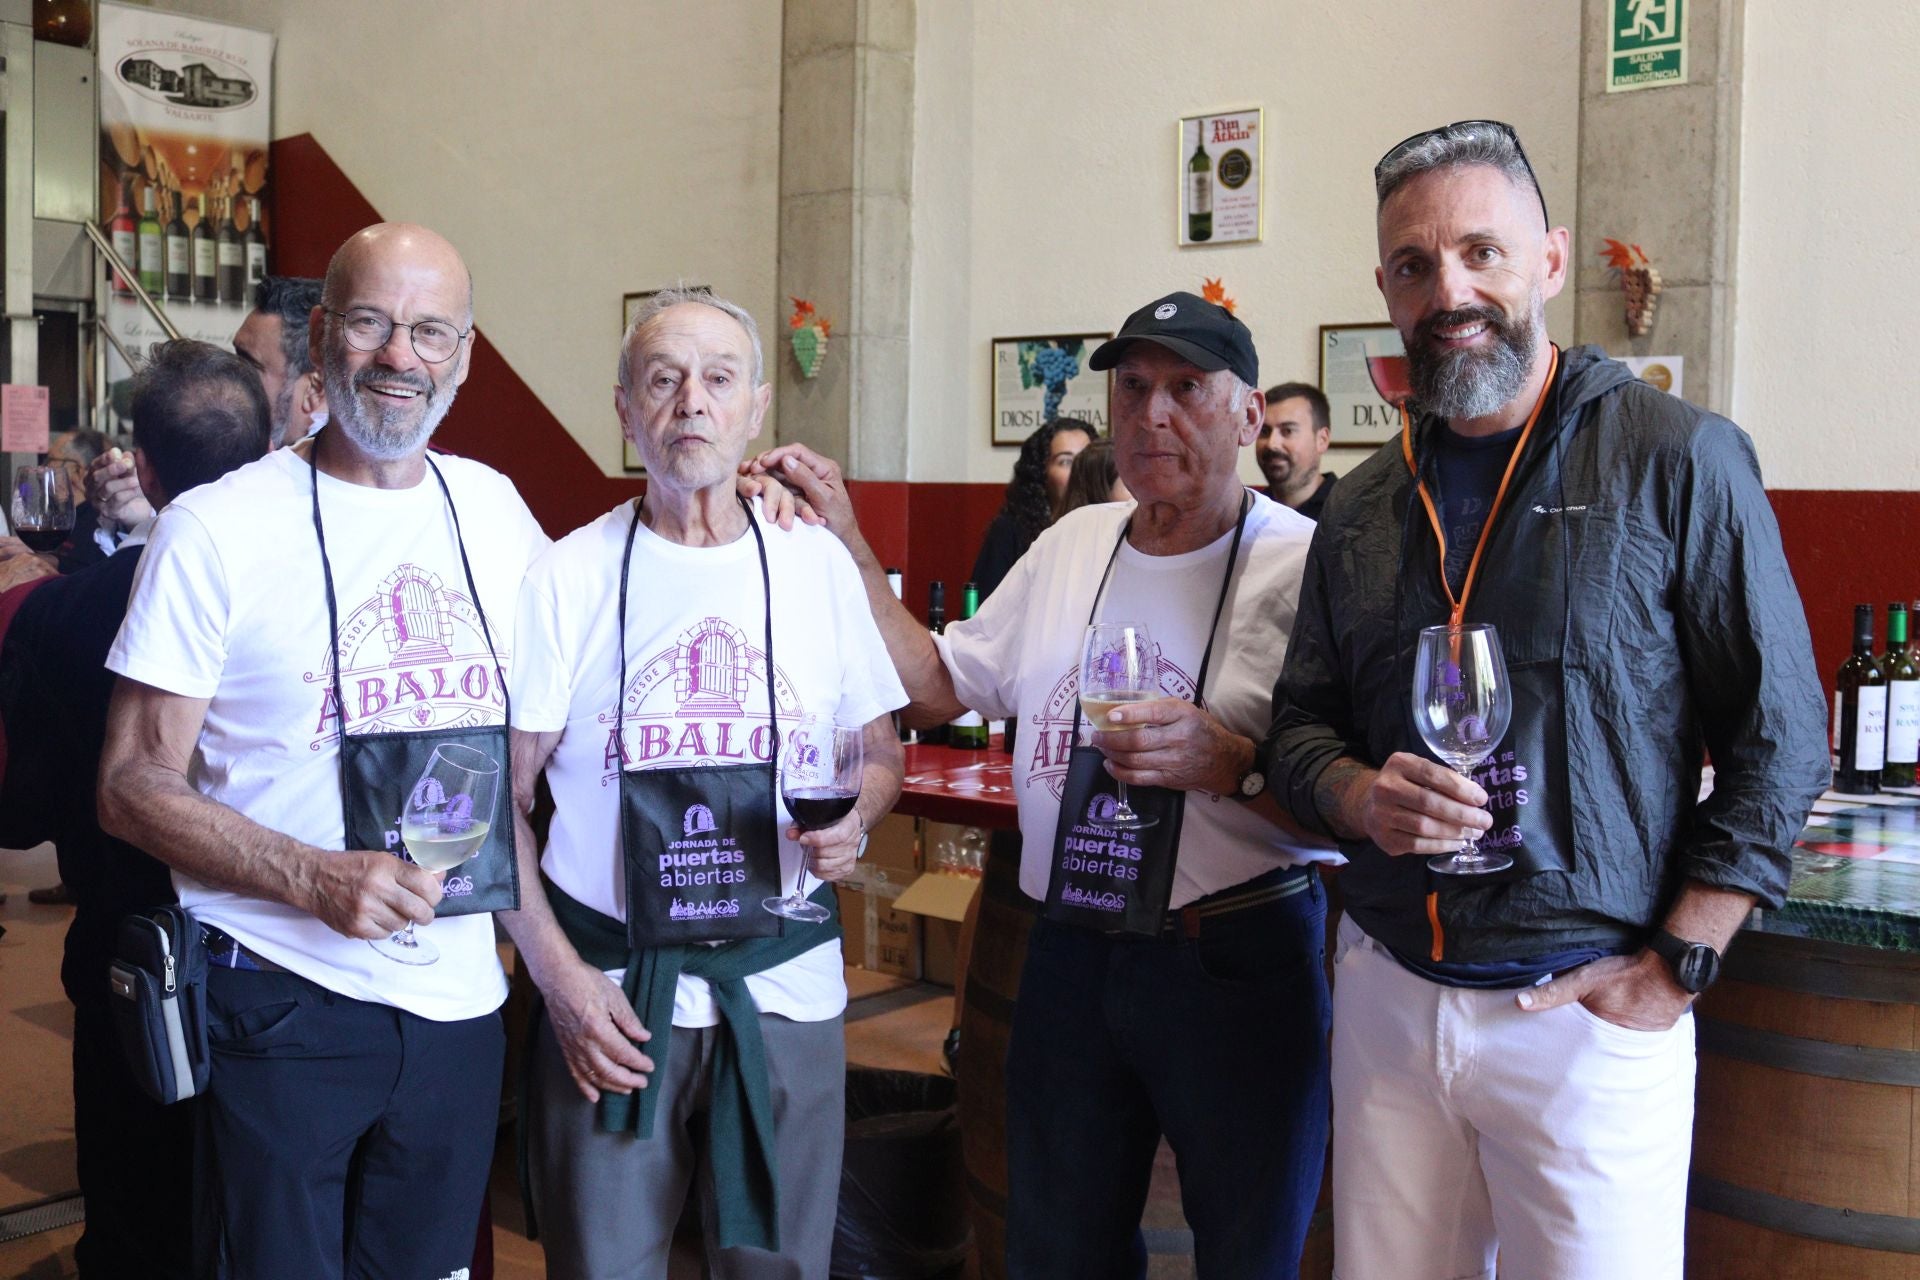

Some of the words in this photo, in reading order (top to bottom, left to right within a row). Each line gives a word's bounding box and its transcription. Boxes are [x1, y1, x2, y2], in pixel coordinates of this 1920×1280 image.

[1629, 51, 1665, 64] SALIDA
[1639, 62, 1653, 73] DE
[1614, 69, 1679, 86] EMERGENCIA
[1211, 118, 1239, 131] Tim
[1211, 129, 1250, 143] Atkin
[1001, 410, 1033, 428] DIOS
[1549, 504, 1587, 514] Quchua
[338, 619, 367, 657] DESDE
[628, 668, 659, 703] DESDE
[1172, 680, 1191, 701] 199
[1501, 751, 1514, 763] DE
[1071, 825, 1118, 838] JORNADA
[1122, 832, 1136, 842] DE
[1480, 825, 1522, 849] ALOS
[668, 839, 718, 849] JORNADA
[722, 838, 736, 846] DE
[1064, 836, 1142, 861] puertas
[659, 848, 745, 871] puertas
[1062, 853, 1138, 881] abiertas
[441, 875, 474, 894] LOS
[660, 868, 746, 887] abiertas
